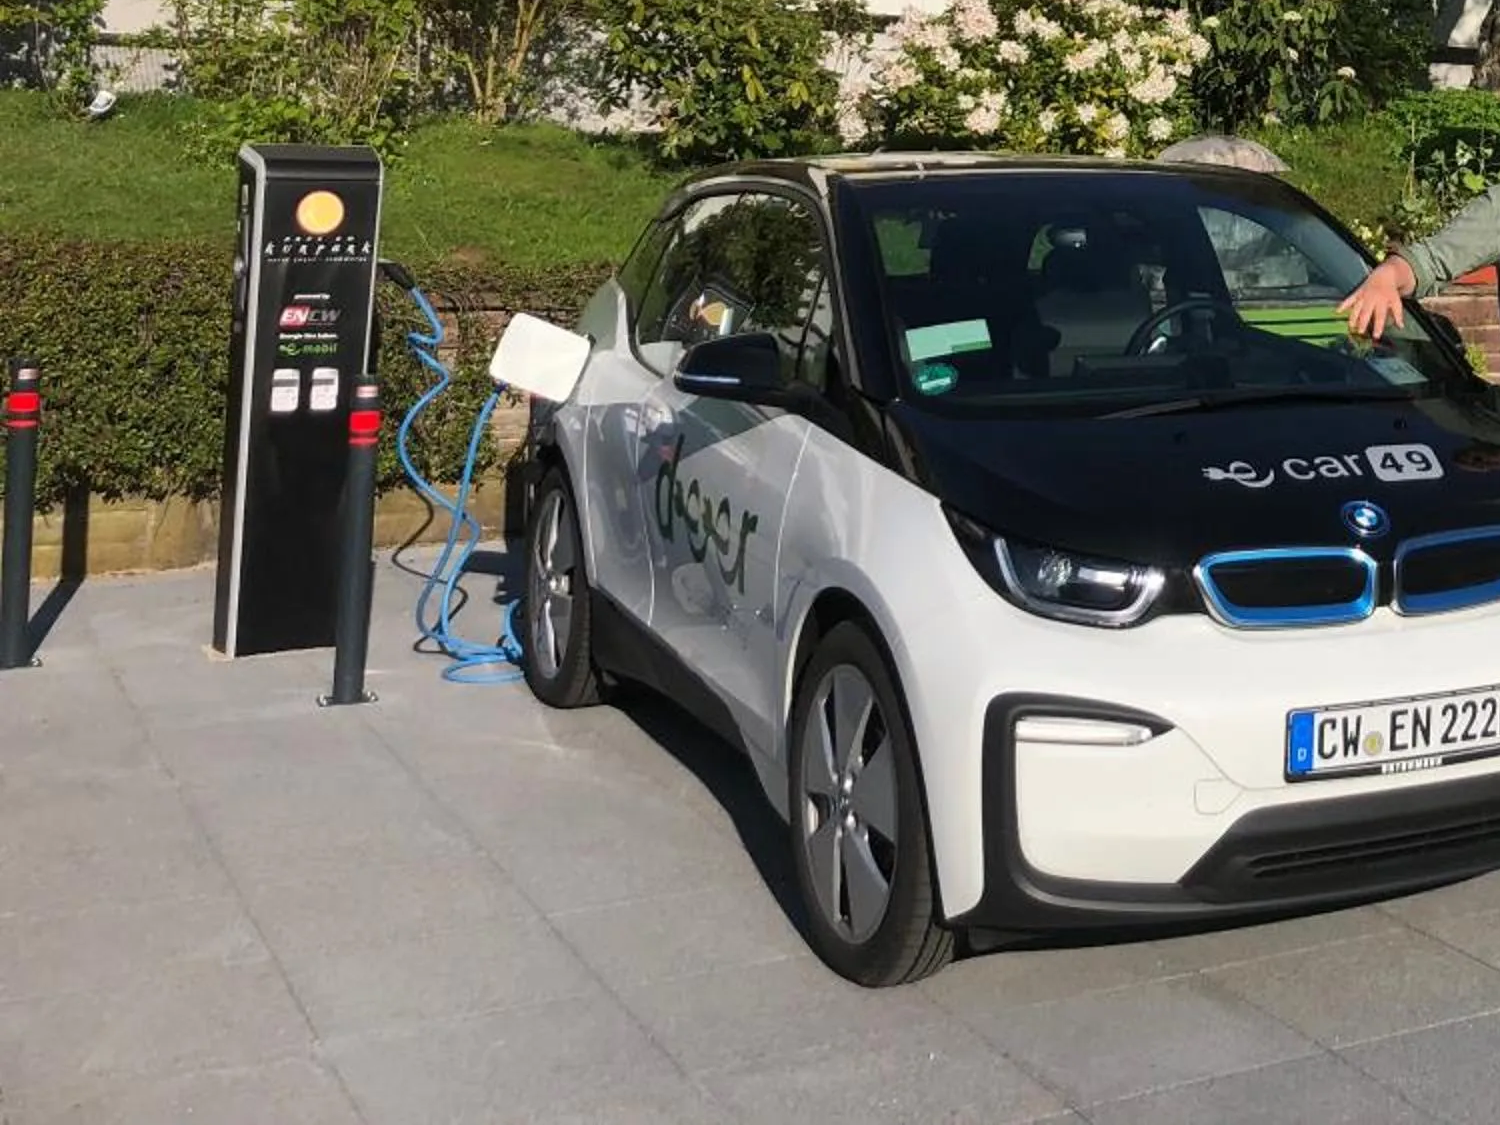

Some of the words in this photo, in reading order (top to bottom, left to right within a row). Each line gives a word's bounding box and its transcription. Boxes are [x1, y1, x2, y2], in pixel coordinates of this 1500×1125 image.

[1379, 450, 1433, 474] 49
[1317, 715, 1363, 760] CW
[1389, 705, 1432, 752] EN
